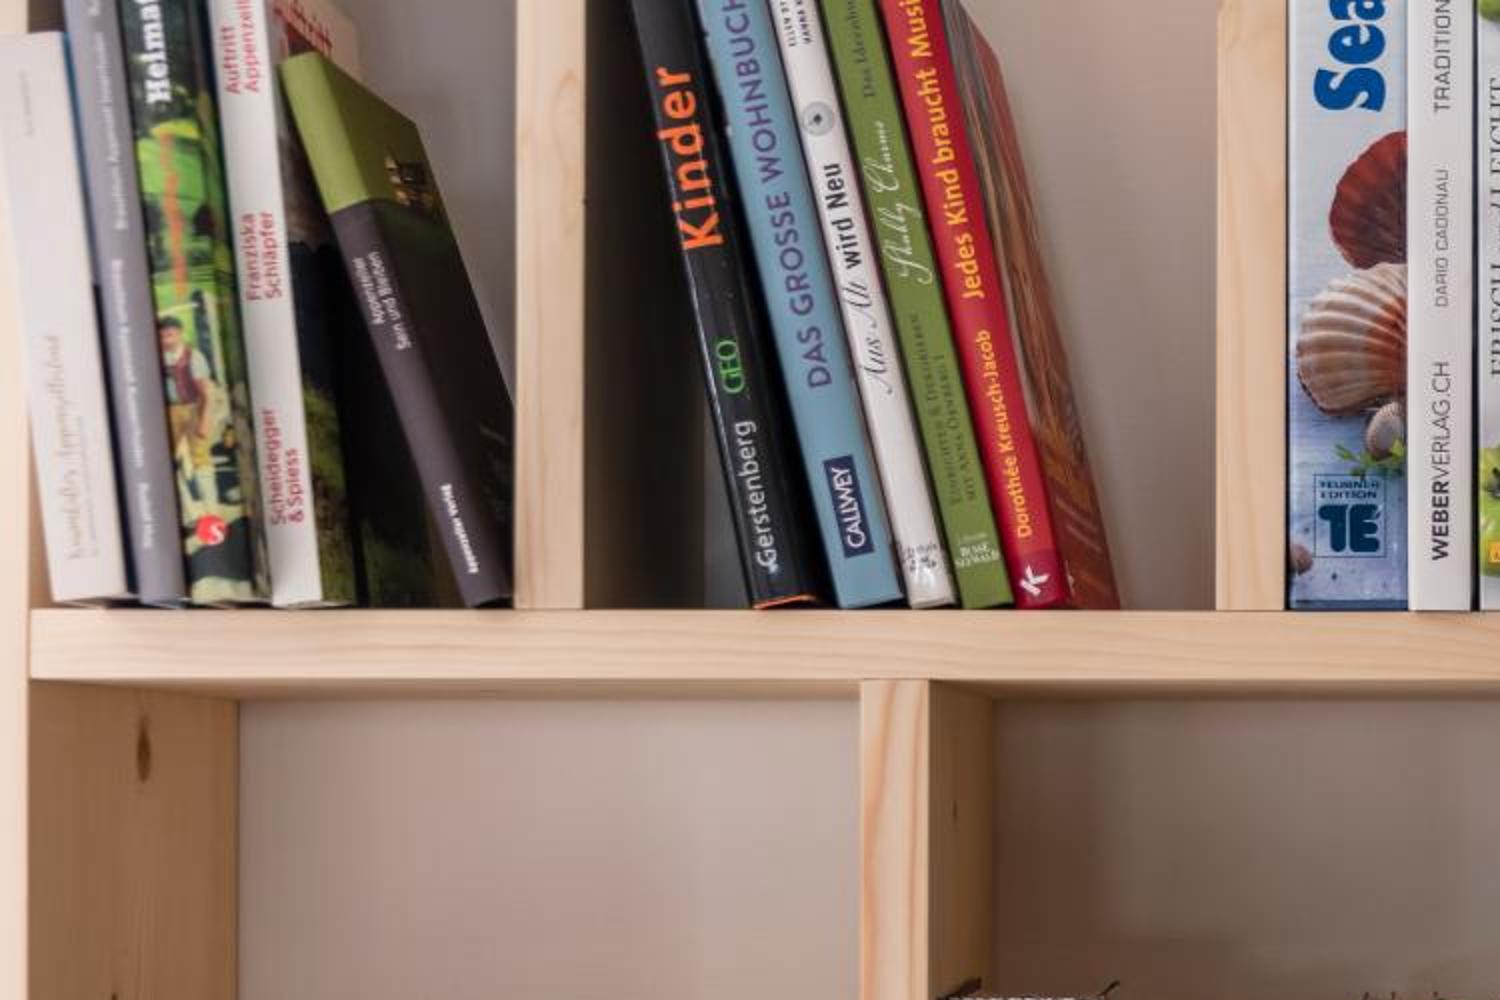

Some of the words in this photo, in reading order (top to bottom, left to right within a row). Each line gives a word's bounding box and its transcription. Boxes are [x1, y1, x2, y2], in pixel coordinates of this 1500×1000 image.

[135, 0, 172, 104] Heima
[222, 25, 241, 95] Auftritt
[658, 67, 724, 249] Kinder
[915, 67, 951, 166] braucht
[823, 162, 845, 207] Neu
[942, 172, 969, 227] Kind
[1433, 168, 1450, 252] CADONAU
[243, 213, 261, 301] Franziska
[264, 210, 282, 299] Schläpfer
[768, 191, 814, 317] GROSSE
[833, 213, 862, 269] wird
[881, 198, 935, 286] Shabby
[952, 231, 984, 299] Jedes
[1433, 261, 1450, 308] DARIO
[715, 339, 745, 393] GEO
[794, 325, 832, 388] DAS
[973, 329, 1013, 453] Kreusch-Jacob
[268, 408, 288, 526] Scheidegger
[286, 448, 303, 505] Spiess
[735, 420, 775, 566] Gerstenberg
[1007, 455, 1033, 539] Dorothée
[1319, 490, 1378, 500] EDITION
[1430, 361, 1451, 561] WEBERVERLAG.CH
[832, 465, 868, 551] CALLWEY
[1318, 504, 1381, 552] TE
